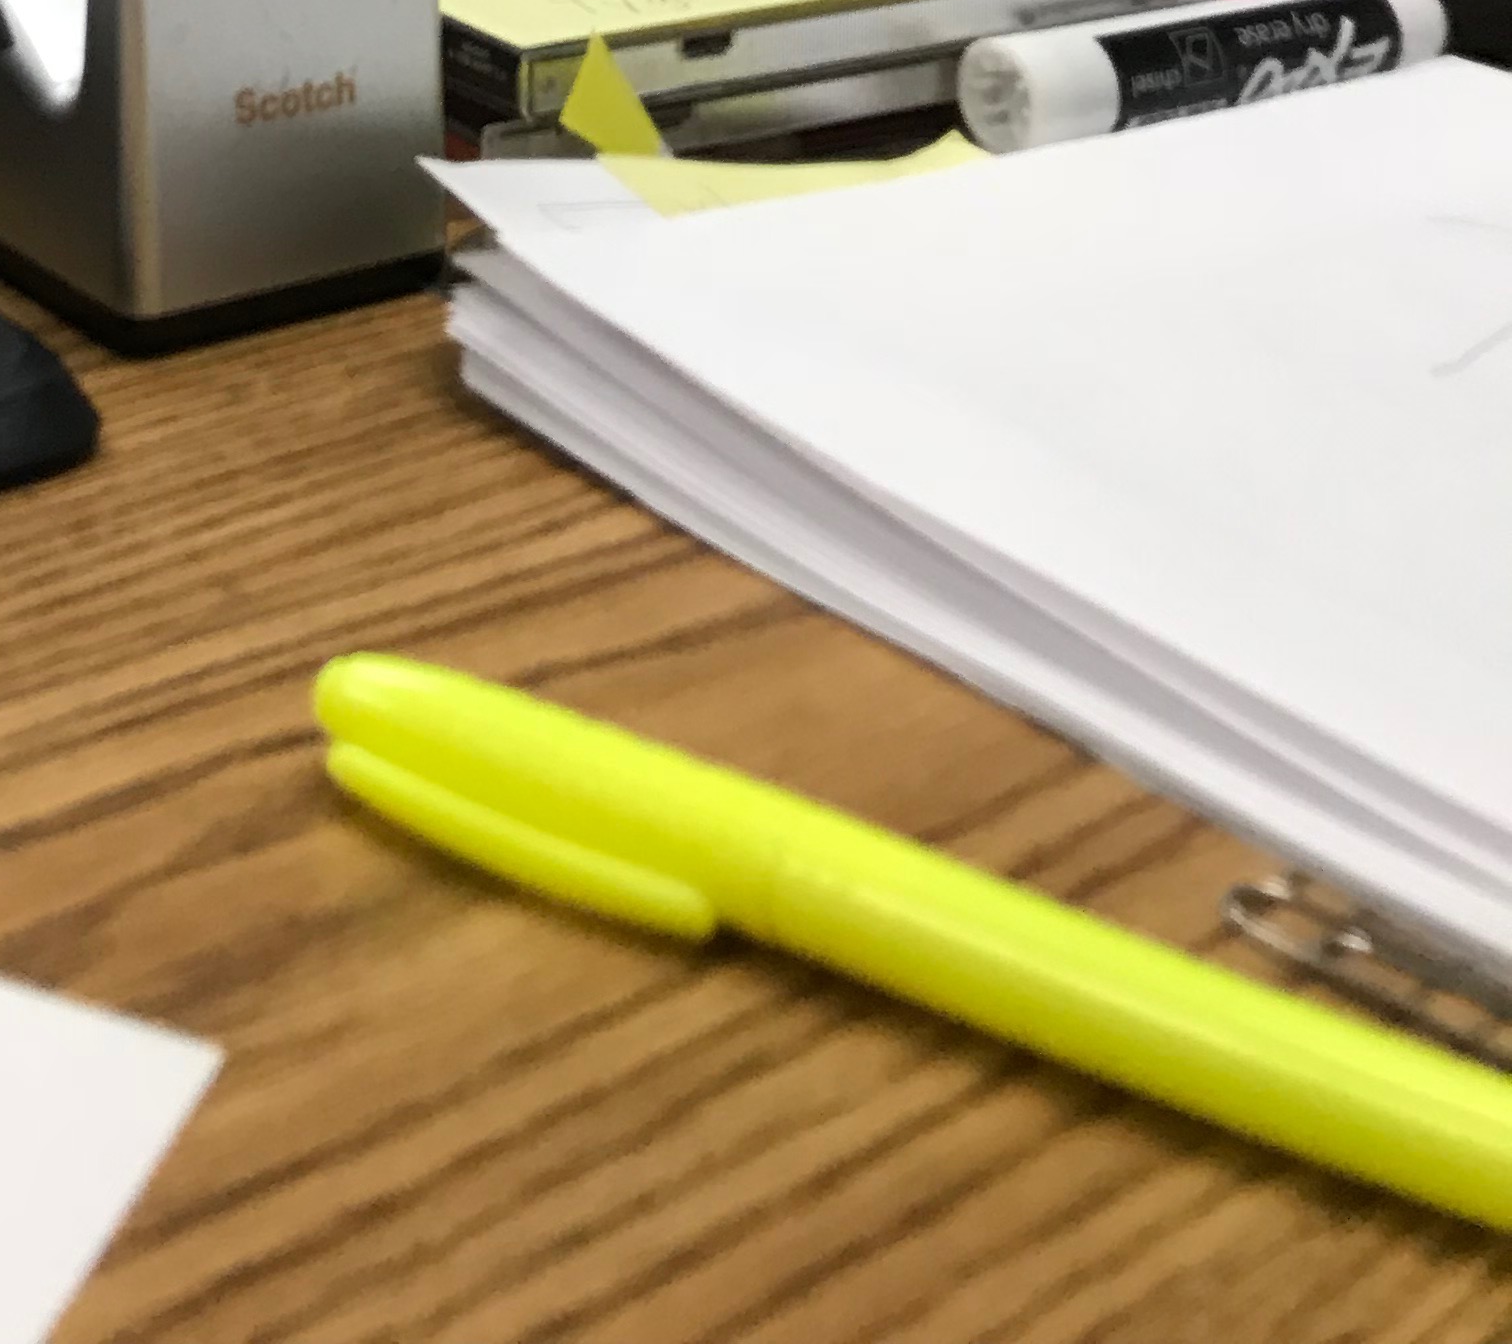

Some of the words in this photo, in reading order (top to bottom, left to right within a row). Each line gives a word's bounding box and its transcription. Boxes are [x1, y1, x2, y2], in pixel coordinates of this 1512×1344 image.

[1233, 18, 1293, 49] erase
[234, 69, 356, 127] Scotch
[1131, 67, 1183, 99] chisel
